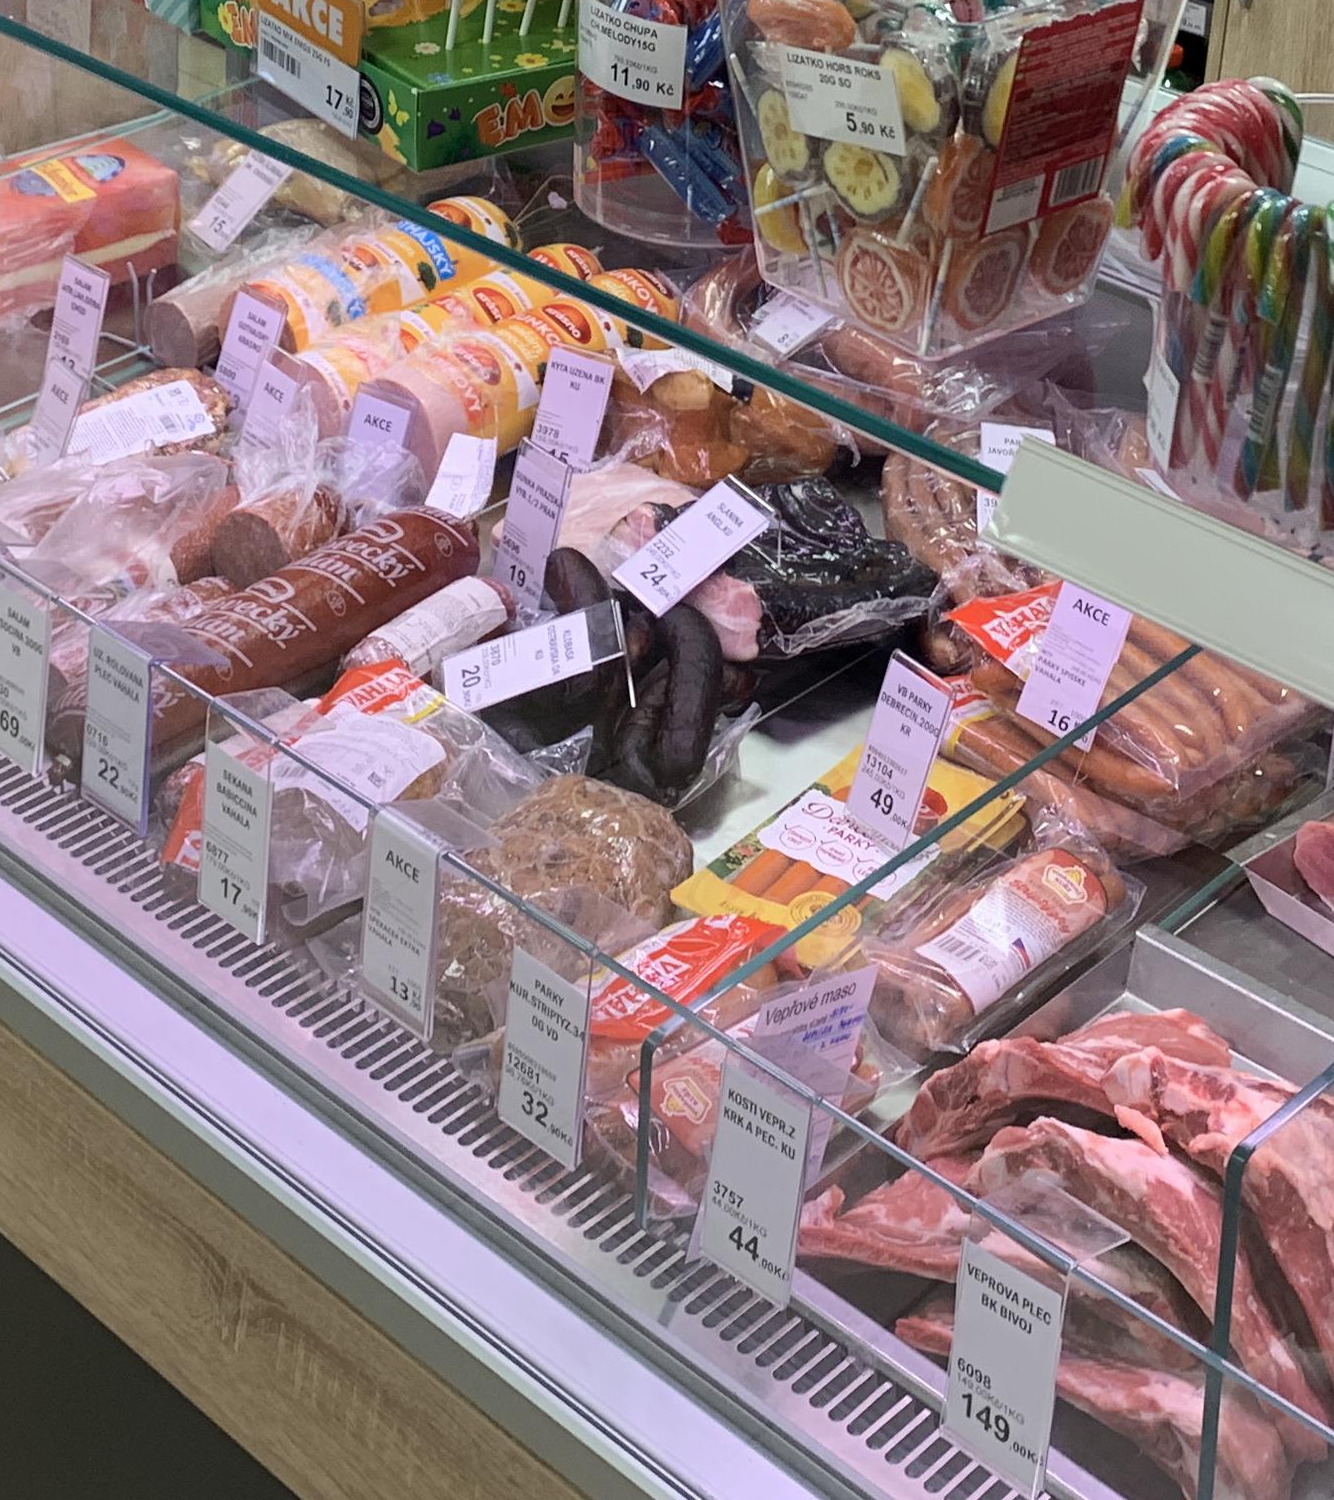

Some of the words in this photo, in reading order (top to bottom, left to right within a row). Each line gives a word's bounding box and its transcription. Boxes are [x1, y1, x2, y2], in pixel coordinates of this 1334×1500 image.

[590, 5, 622, 28] LIZATKO
[623, 18, 658, 40] CHUPA
[786, 52, 824, 70] LIZATKO
[826, 58, 852, 75] HORS
[853, 65, 881, 81] ROKS
[326, 85, 343, 110] 17
[656, 82, 674, 97] Kč
[880, 124, 896, 140] Kč
[264, 382, 284, 404] AKCE
[364, 412, 393, 434] AKCE
[509, 565, 526, 587] 19
[640, 563, 669, 587] 24
[1073, 598, 1111, 626] AKCE
[345, 669, 424, 709] VAHALA
[461, 664, 481, 688] 20
[897, 683, 908, 697] VB
[907, 689, 933, 714] PARKY
[0, 709, 20, 738] 69
[900, 722, 912, 737] KR
[1048, 708, 1070, 732] 16
[97, 757, 121, 789] 22
[866, 753, 894, 780] 13104
[222, 768, 253, 798] SEKANA
[221, 802, 250, 830] VAHALA
[869, 788, 894, 815] 49
[827, 827, 874, 853] PARKY
[385, 849, 421, 885] AKCE
[220, 877, 242, 905] 17
[389, 974, 409, 1002] 13
[533, 978, 564, 1008] PARKY
[764, 991, 821, 1028] Vepřové
[822, 981, 857, 1009] maso
[505, 1051, 541, 1084] 12681
[520, 1090, 548, 1128] 32
[727, 1087, 759, 1114] KOSTI
[758, 1101, 796, 1139] VEPR.Z
[724, 1105, 747, 1129] KRK
[746, 1119, 755, 1132] A
[754, 1122, 779, 1153] PEC.
[782, 1141, 796, 1161] KU
[713, 1180, 745, 1209] 3757
[728, 1224, 760, 1261] 44
[967, 1262, 1020, 1305] VEPROVA
[1021, 1296, 1052, 1325] PLEC
[981, 1293, 999, 1315] BK
[999, 1303, 1033, 1334] BIVOJ
[957, 1357, 992, 1390] 6098
[962, 1393, 1010, 1444] 149
